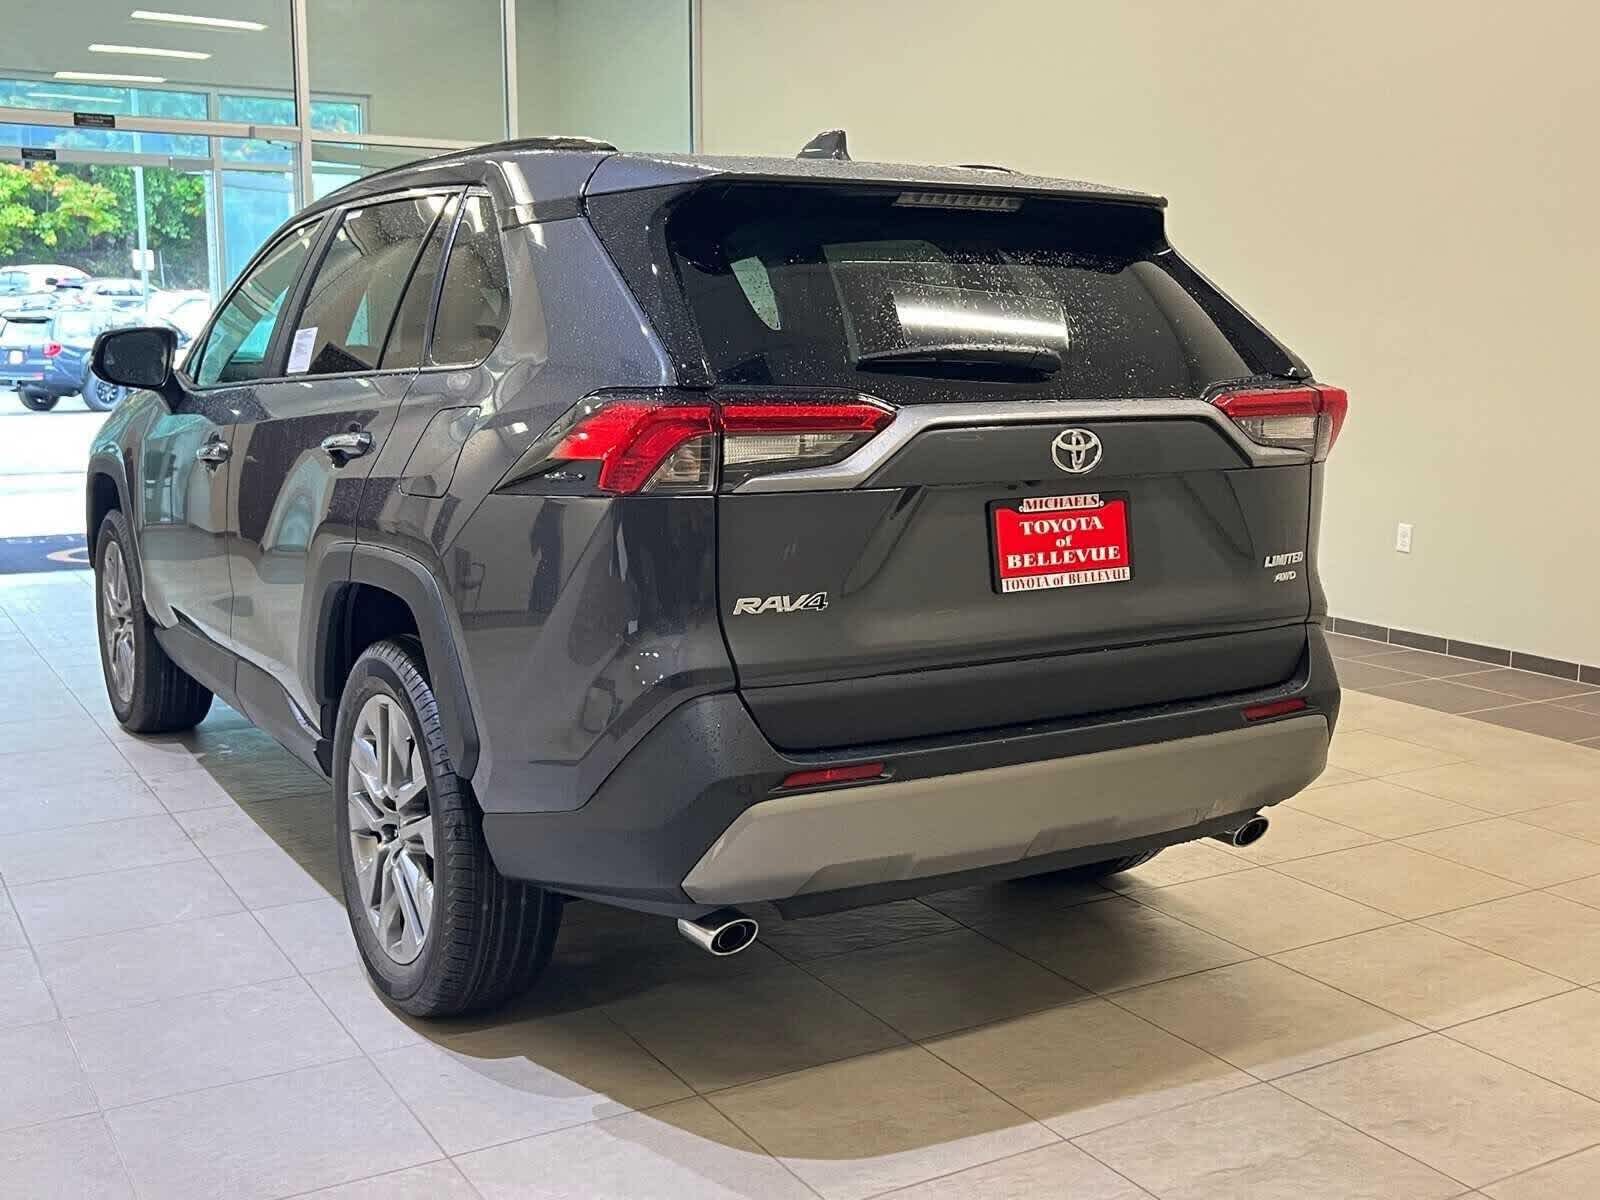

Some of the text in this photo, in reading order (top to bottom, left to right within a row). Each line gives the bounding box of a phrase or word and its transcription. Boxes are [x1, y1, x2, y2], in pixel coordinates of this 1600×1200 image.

[1025, 495, 1098, 510] MICHAELS
[1019, 517, 1104, 535] TOYOTA
[1056, 535, 1072, 547] of
[1007, 546, 1120, 568] BELLEVUE
[1264, 551, 1303, 568] LIMITED
[1005, 568, 1128, 590] TOYOTA of BELLEVUE
[1273, 571, 1296, 583] AWD
[733, 591, 829, 615] RAV4
